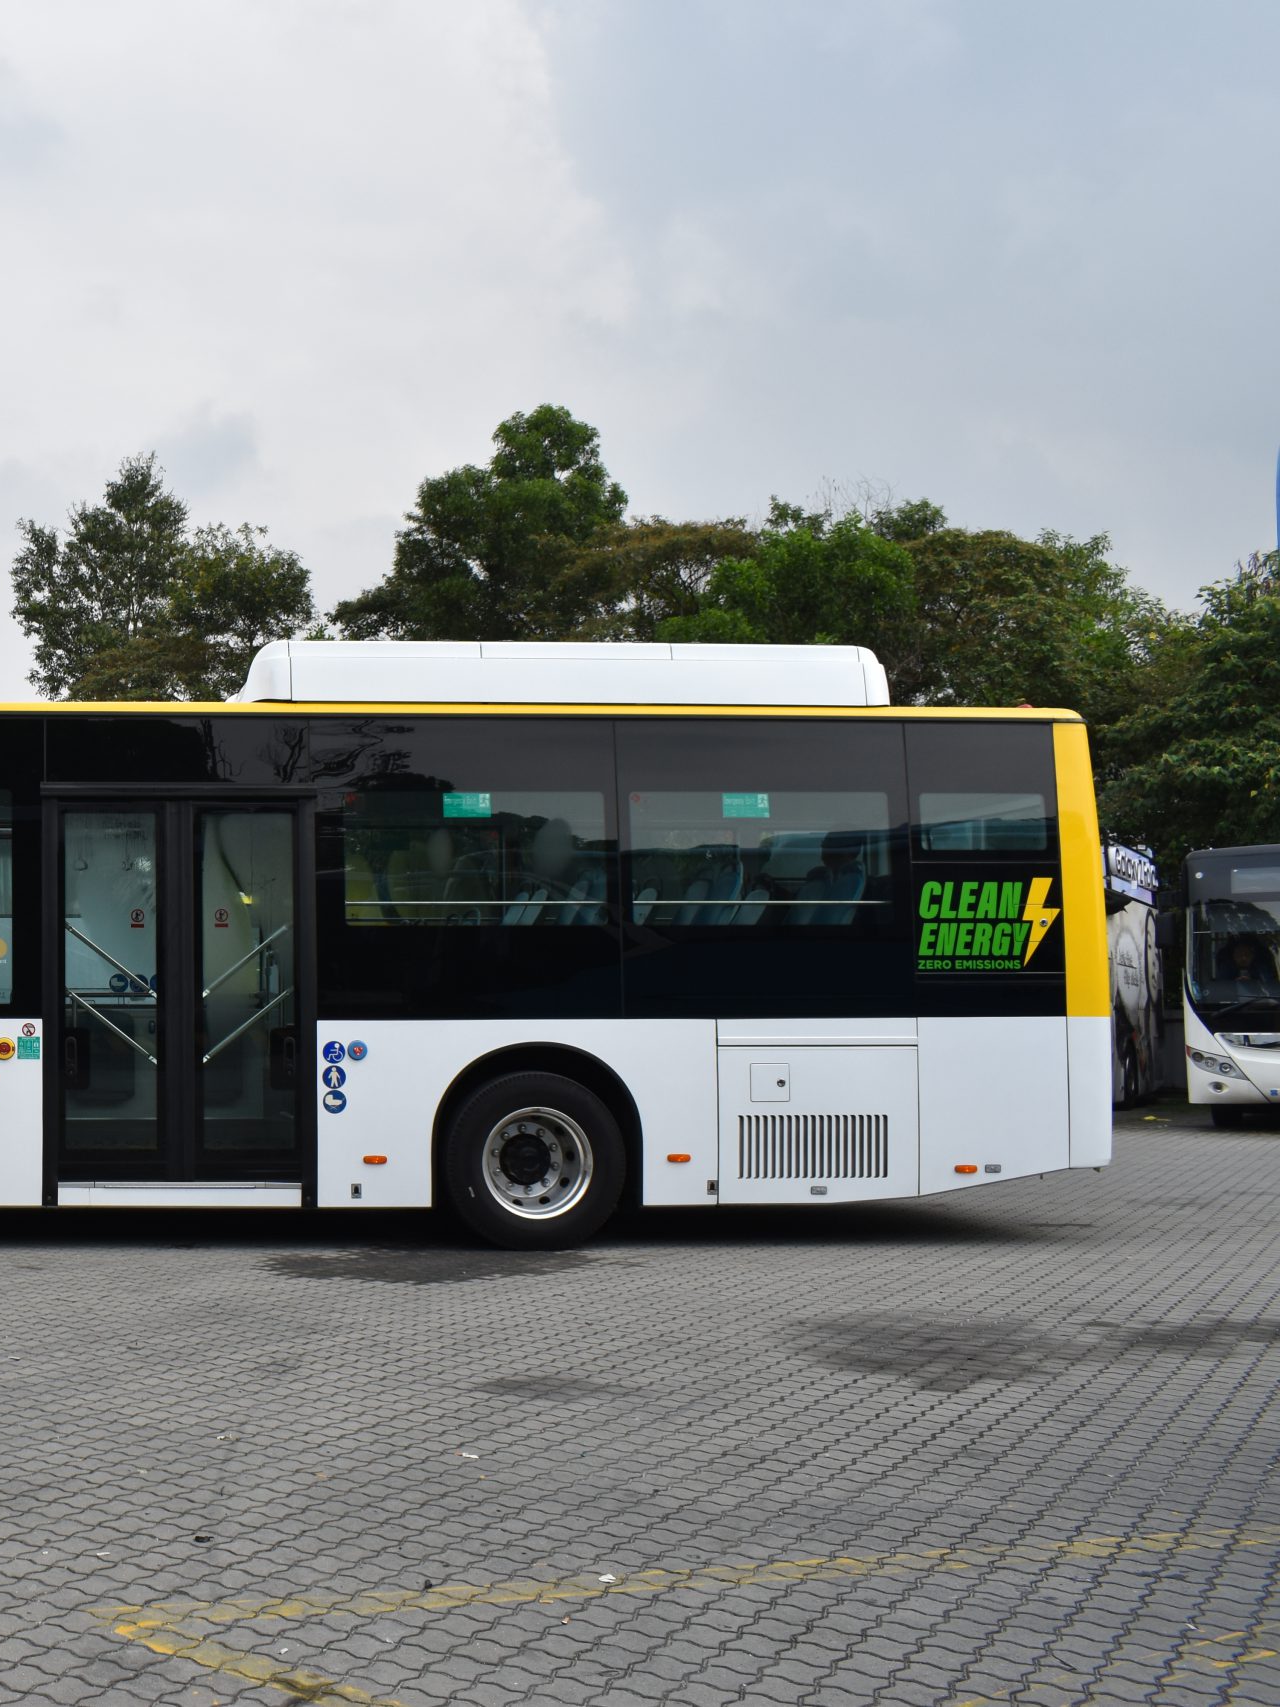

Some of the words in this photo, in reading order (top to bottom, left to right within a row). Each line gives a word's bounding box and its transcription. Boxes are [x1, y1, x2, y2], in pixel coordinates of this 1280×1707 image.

[918, 880, 1023, 920] CLEAN
[918, 922, 1031, 957] ENERGY
[918, 960, 952, 970] ZERO
[954, 960, 1021, 970] EMISSIONS
